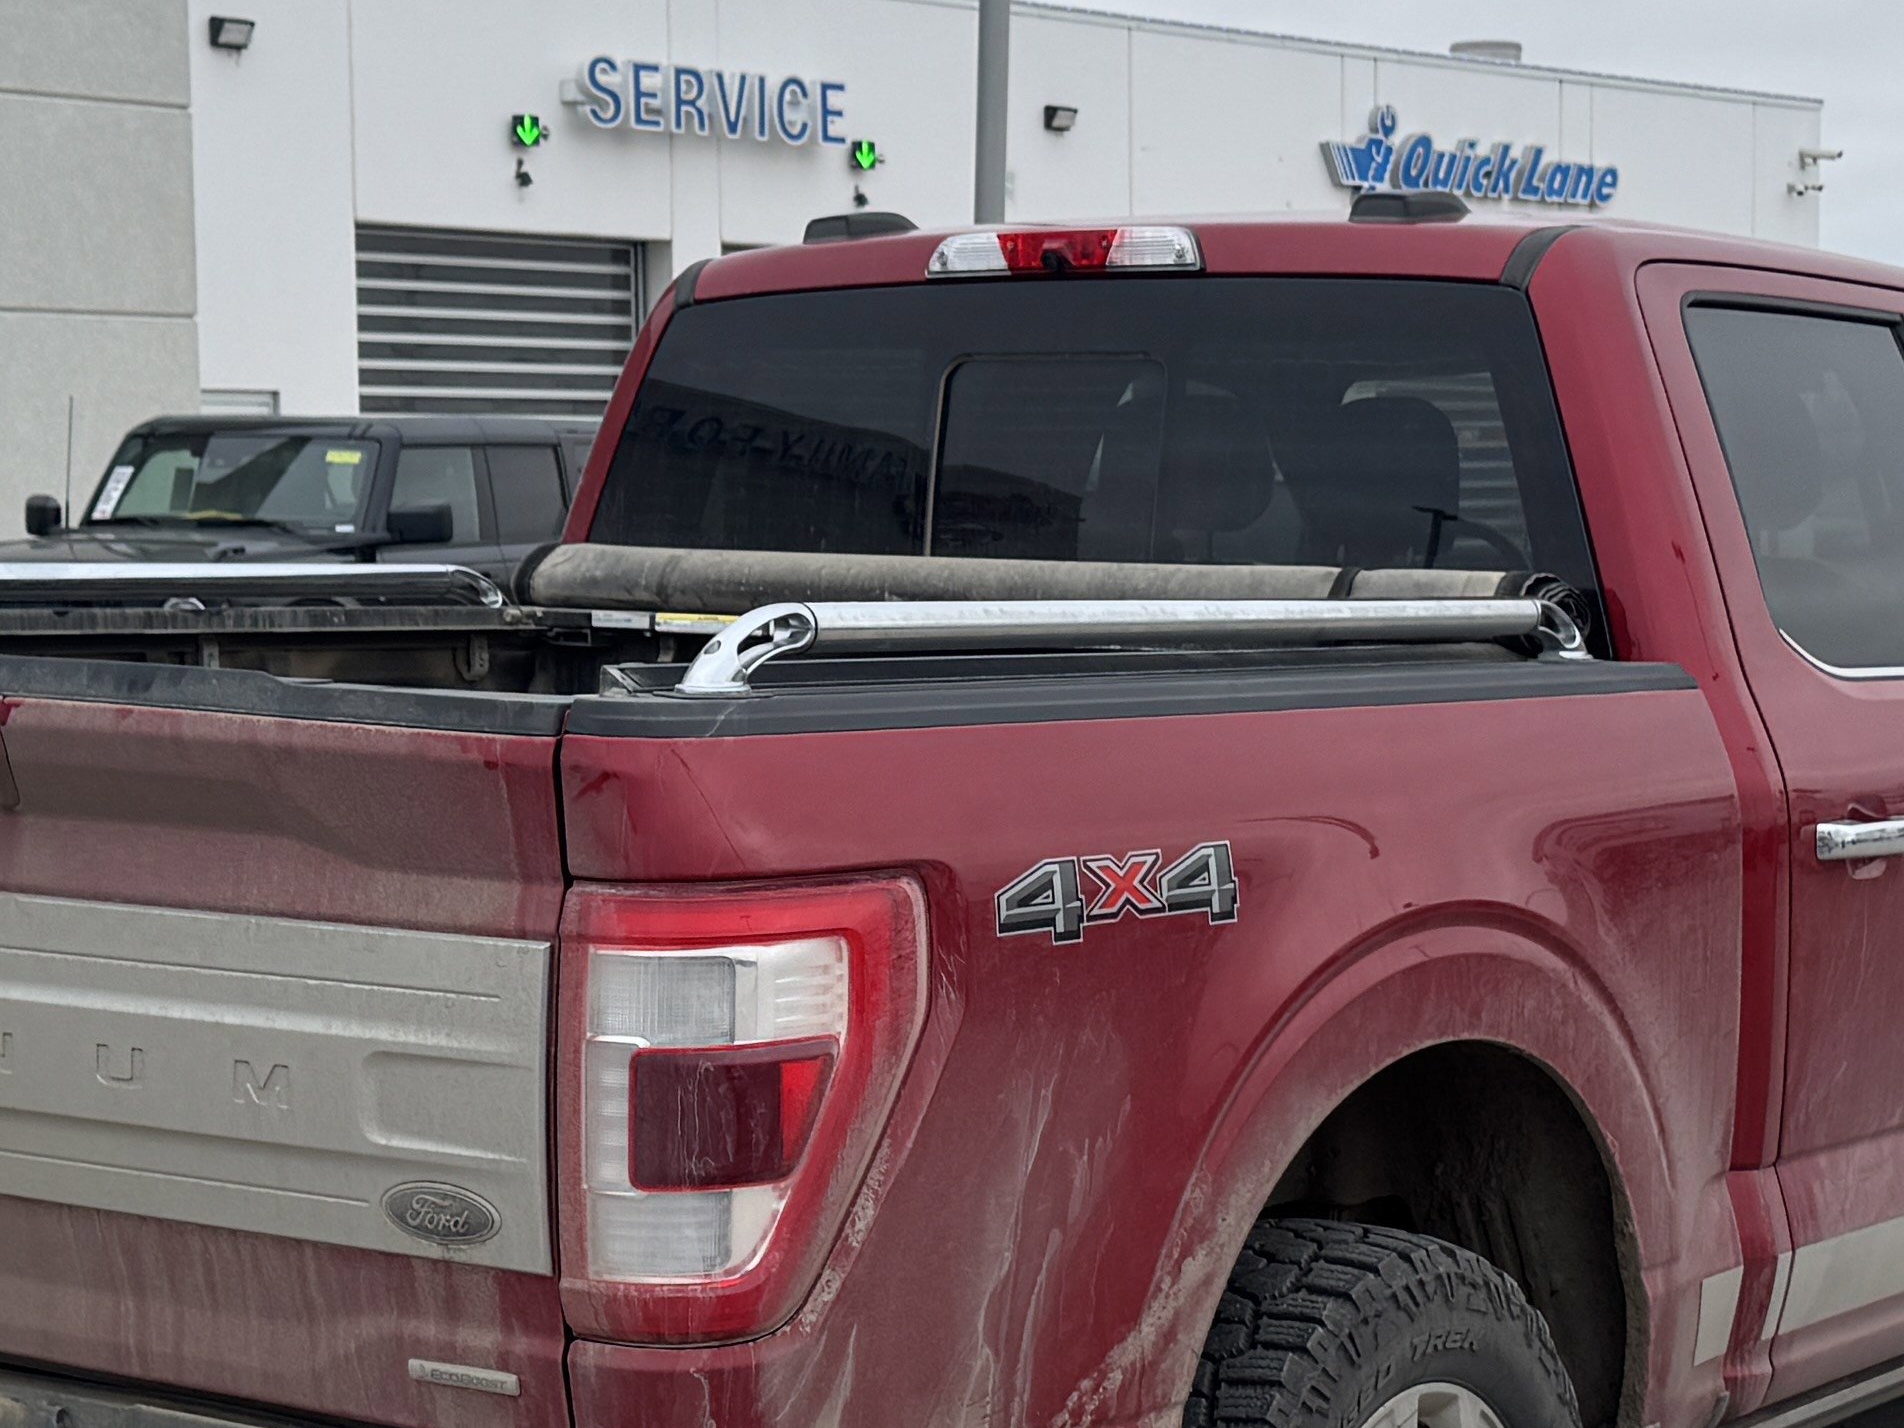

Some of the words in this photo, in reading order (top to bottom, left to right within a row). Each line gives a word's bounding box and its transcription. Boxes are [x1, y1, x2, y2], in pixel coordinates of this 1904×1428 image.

[586, 56, 847, 145] SERVICE
[1399, 133, 1520, 197] Quick
[1518, 145, 1619, 205] Lane
[405, 1193, 470, 1235] Ford
